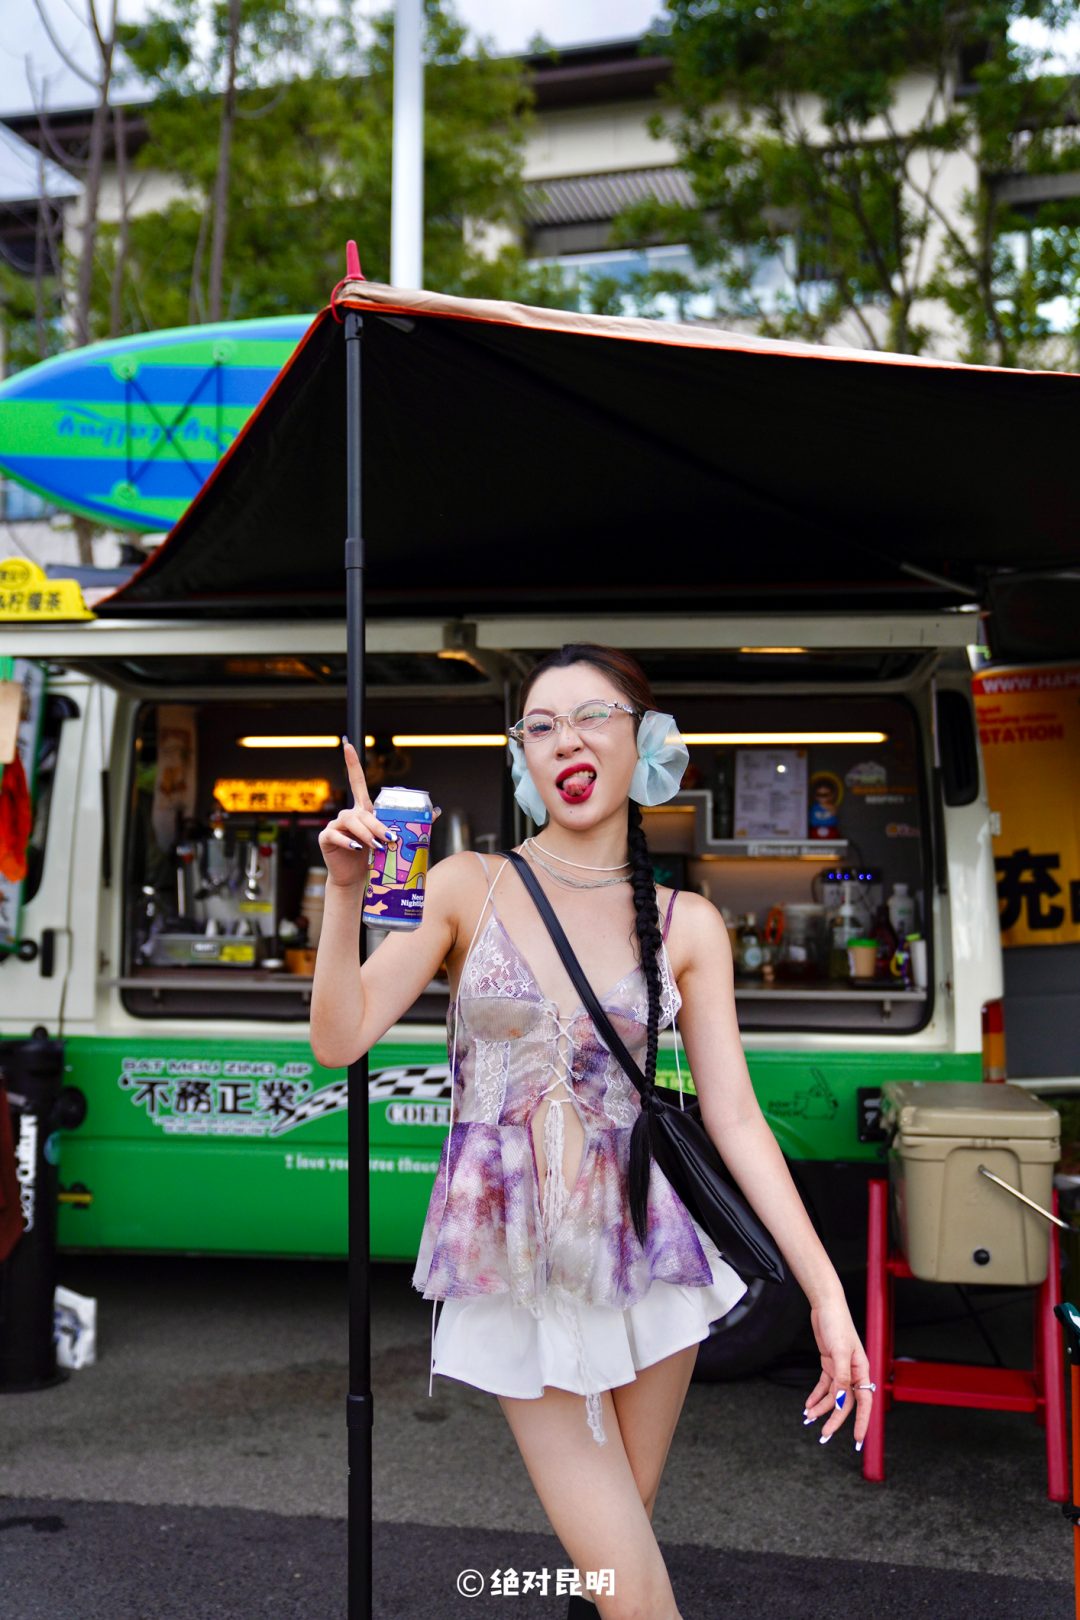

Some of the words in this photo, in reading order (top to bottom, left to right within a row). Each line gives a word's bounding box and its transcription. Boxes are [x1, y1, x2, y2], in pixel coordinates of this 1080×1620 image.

[979, 725, 1064, 746] STATION
[994, 847, 1080, 932] 充
[123, 1059, 164, 1073] BAT
[168, 1060, 219, 1074] MOU
[280, 1064, 311, 1076] JIP
[296, 1155, 326, 1170] love
